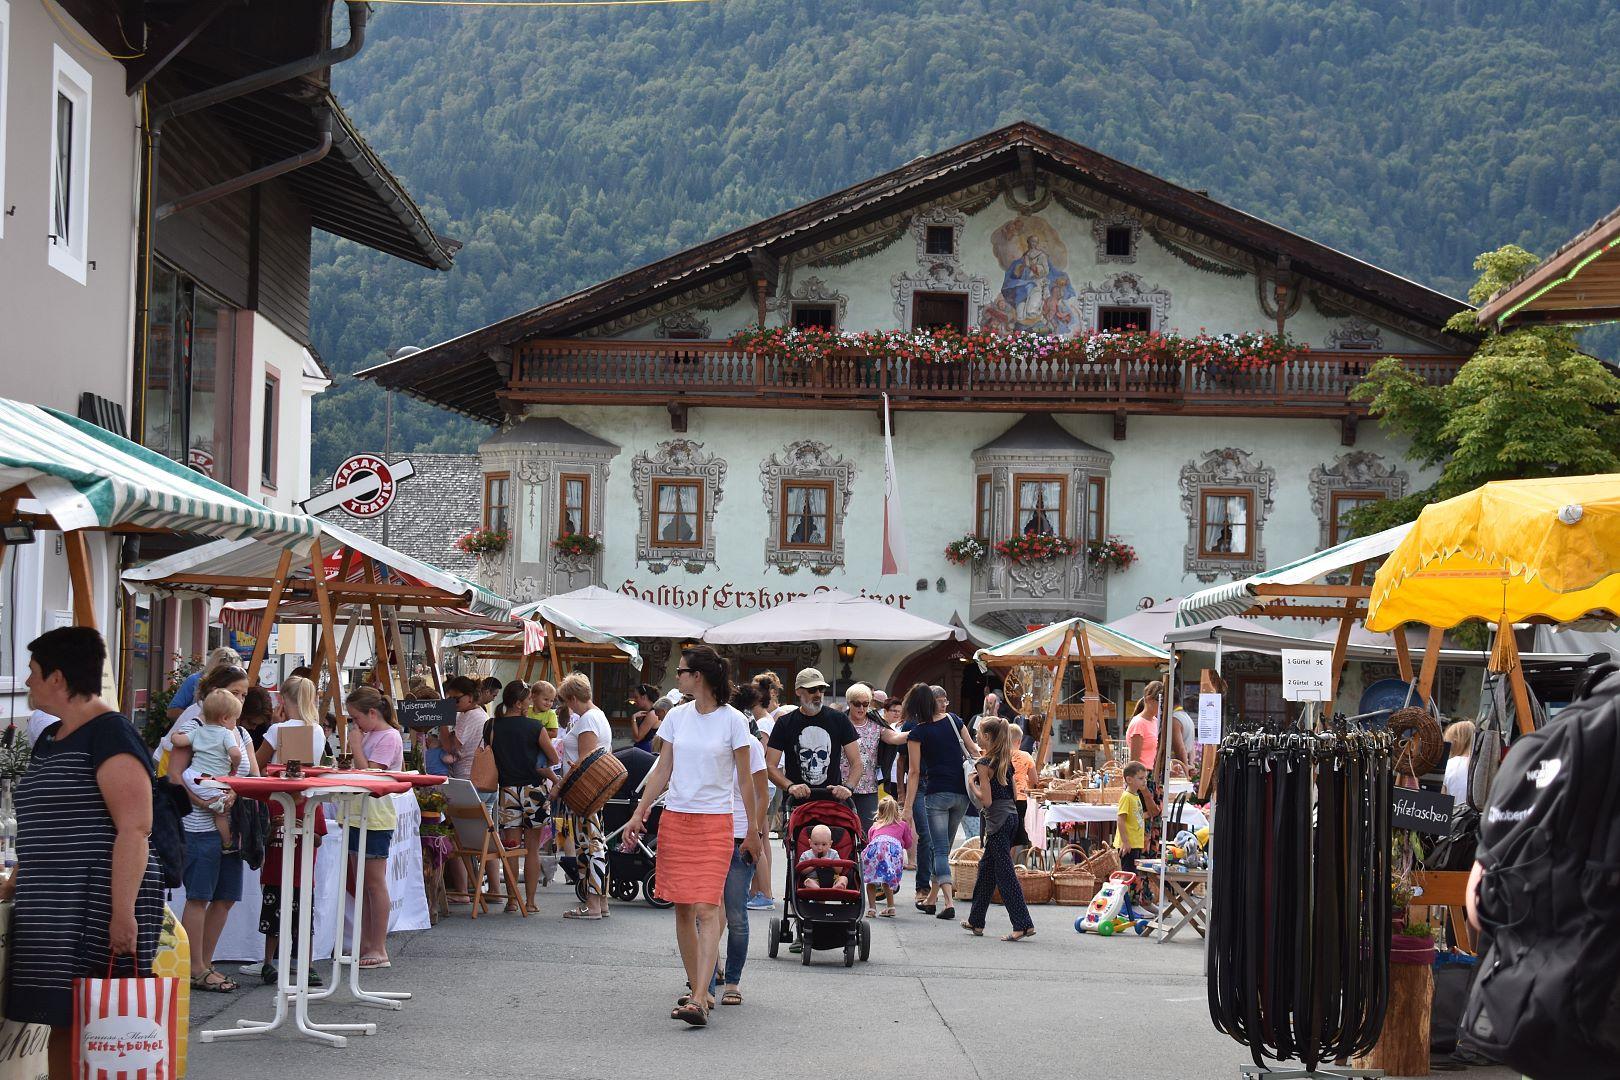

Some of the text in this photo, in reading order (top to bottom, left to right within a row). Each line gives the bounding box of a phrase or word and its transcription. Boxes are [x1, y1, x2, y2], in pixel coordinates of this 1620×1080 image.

[338, 459, 381, 484] TABAK
[350, 481, 391, 513] TRAFIK
[413, 710, 443, 722] Sennerei
[88, 1040, 163, 1052] Kitzbühel
